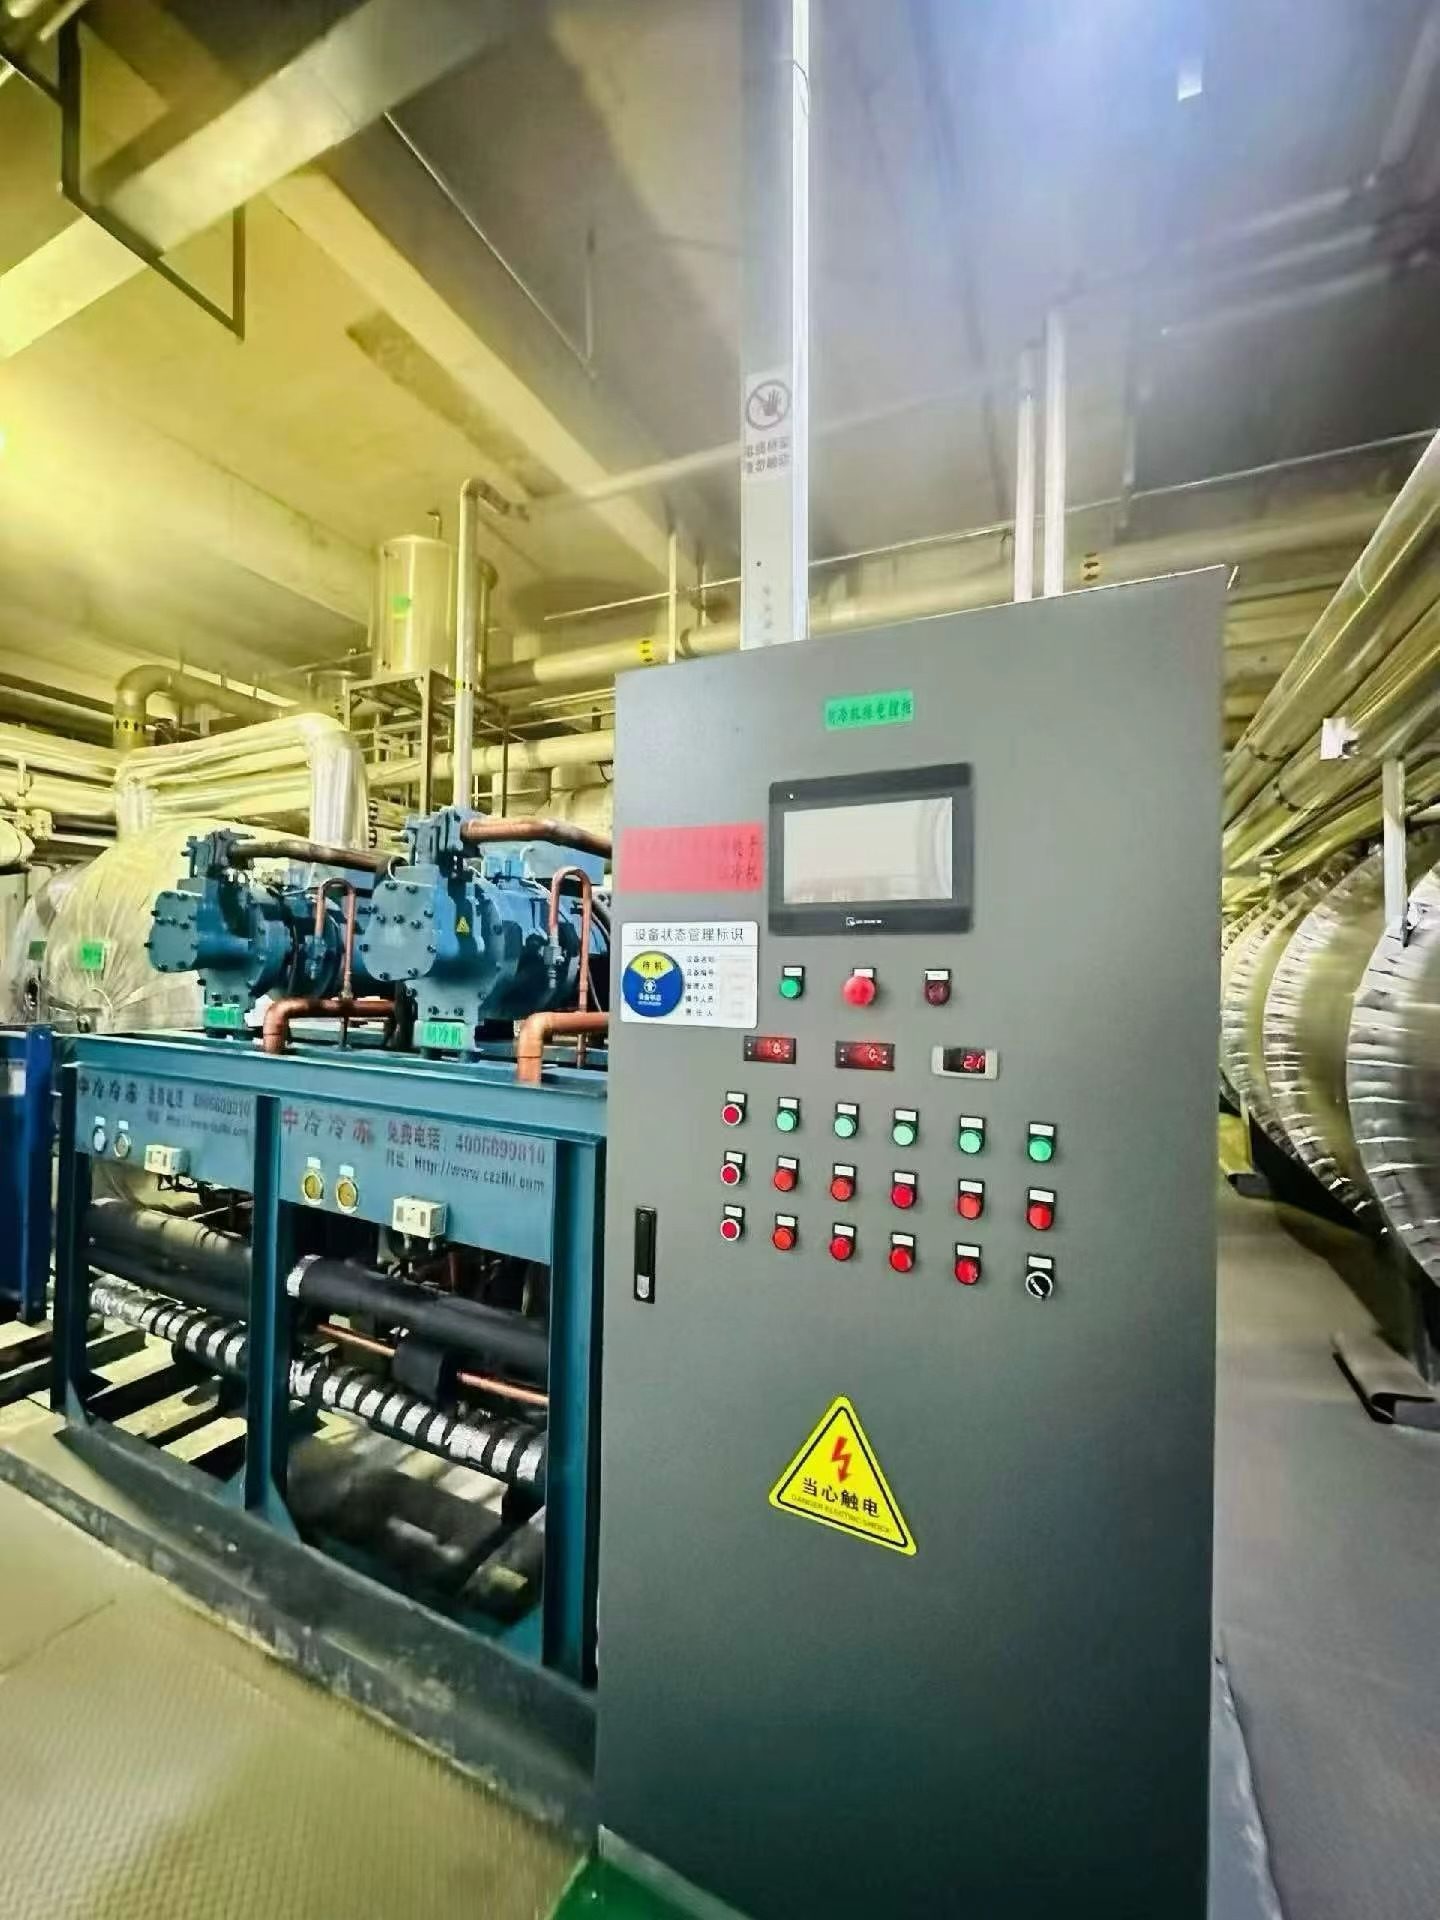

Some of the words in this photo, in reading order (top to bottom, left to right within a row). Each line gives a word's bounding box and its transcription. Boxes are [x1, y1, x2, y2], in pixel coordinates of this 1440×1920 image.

[634, 927, 744, 942] 设备状态管理标识
[642, 961, 663, 971] 待机
[803, 1477, 880, 1518] 当心触电
